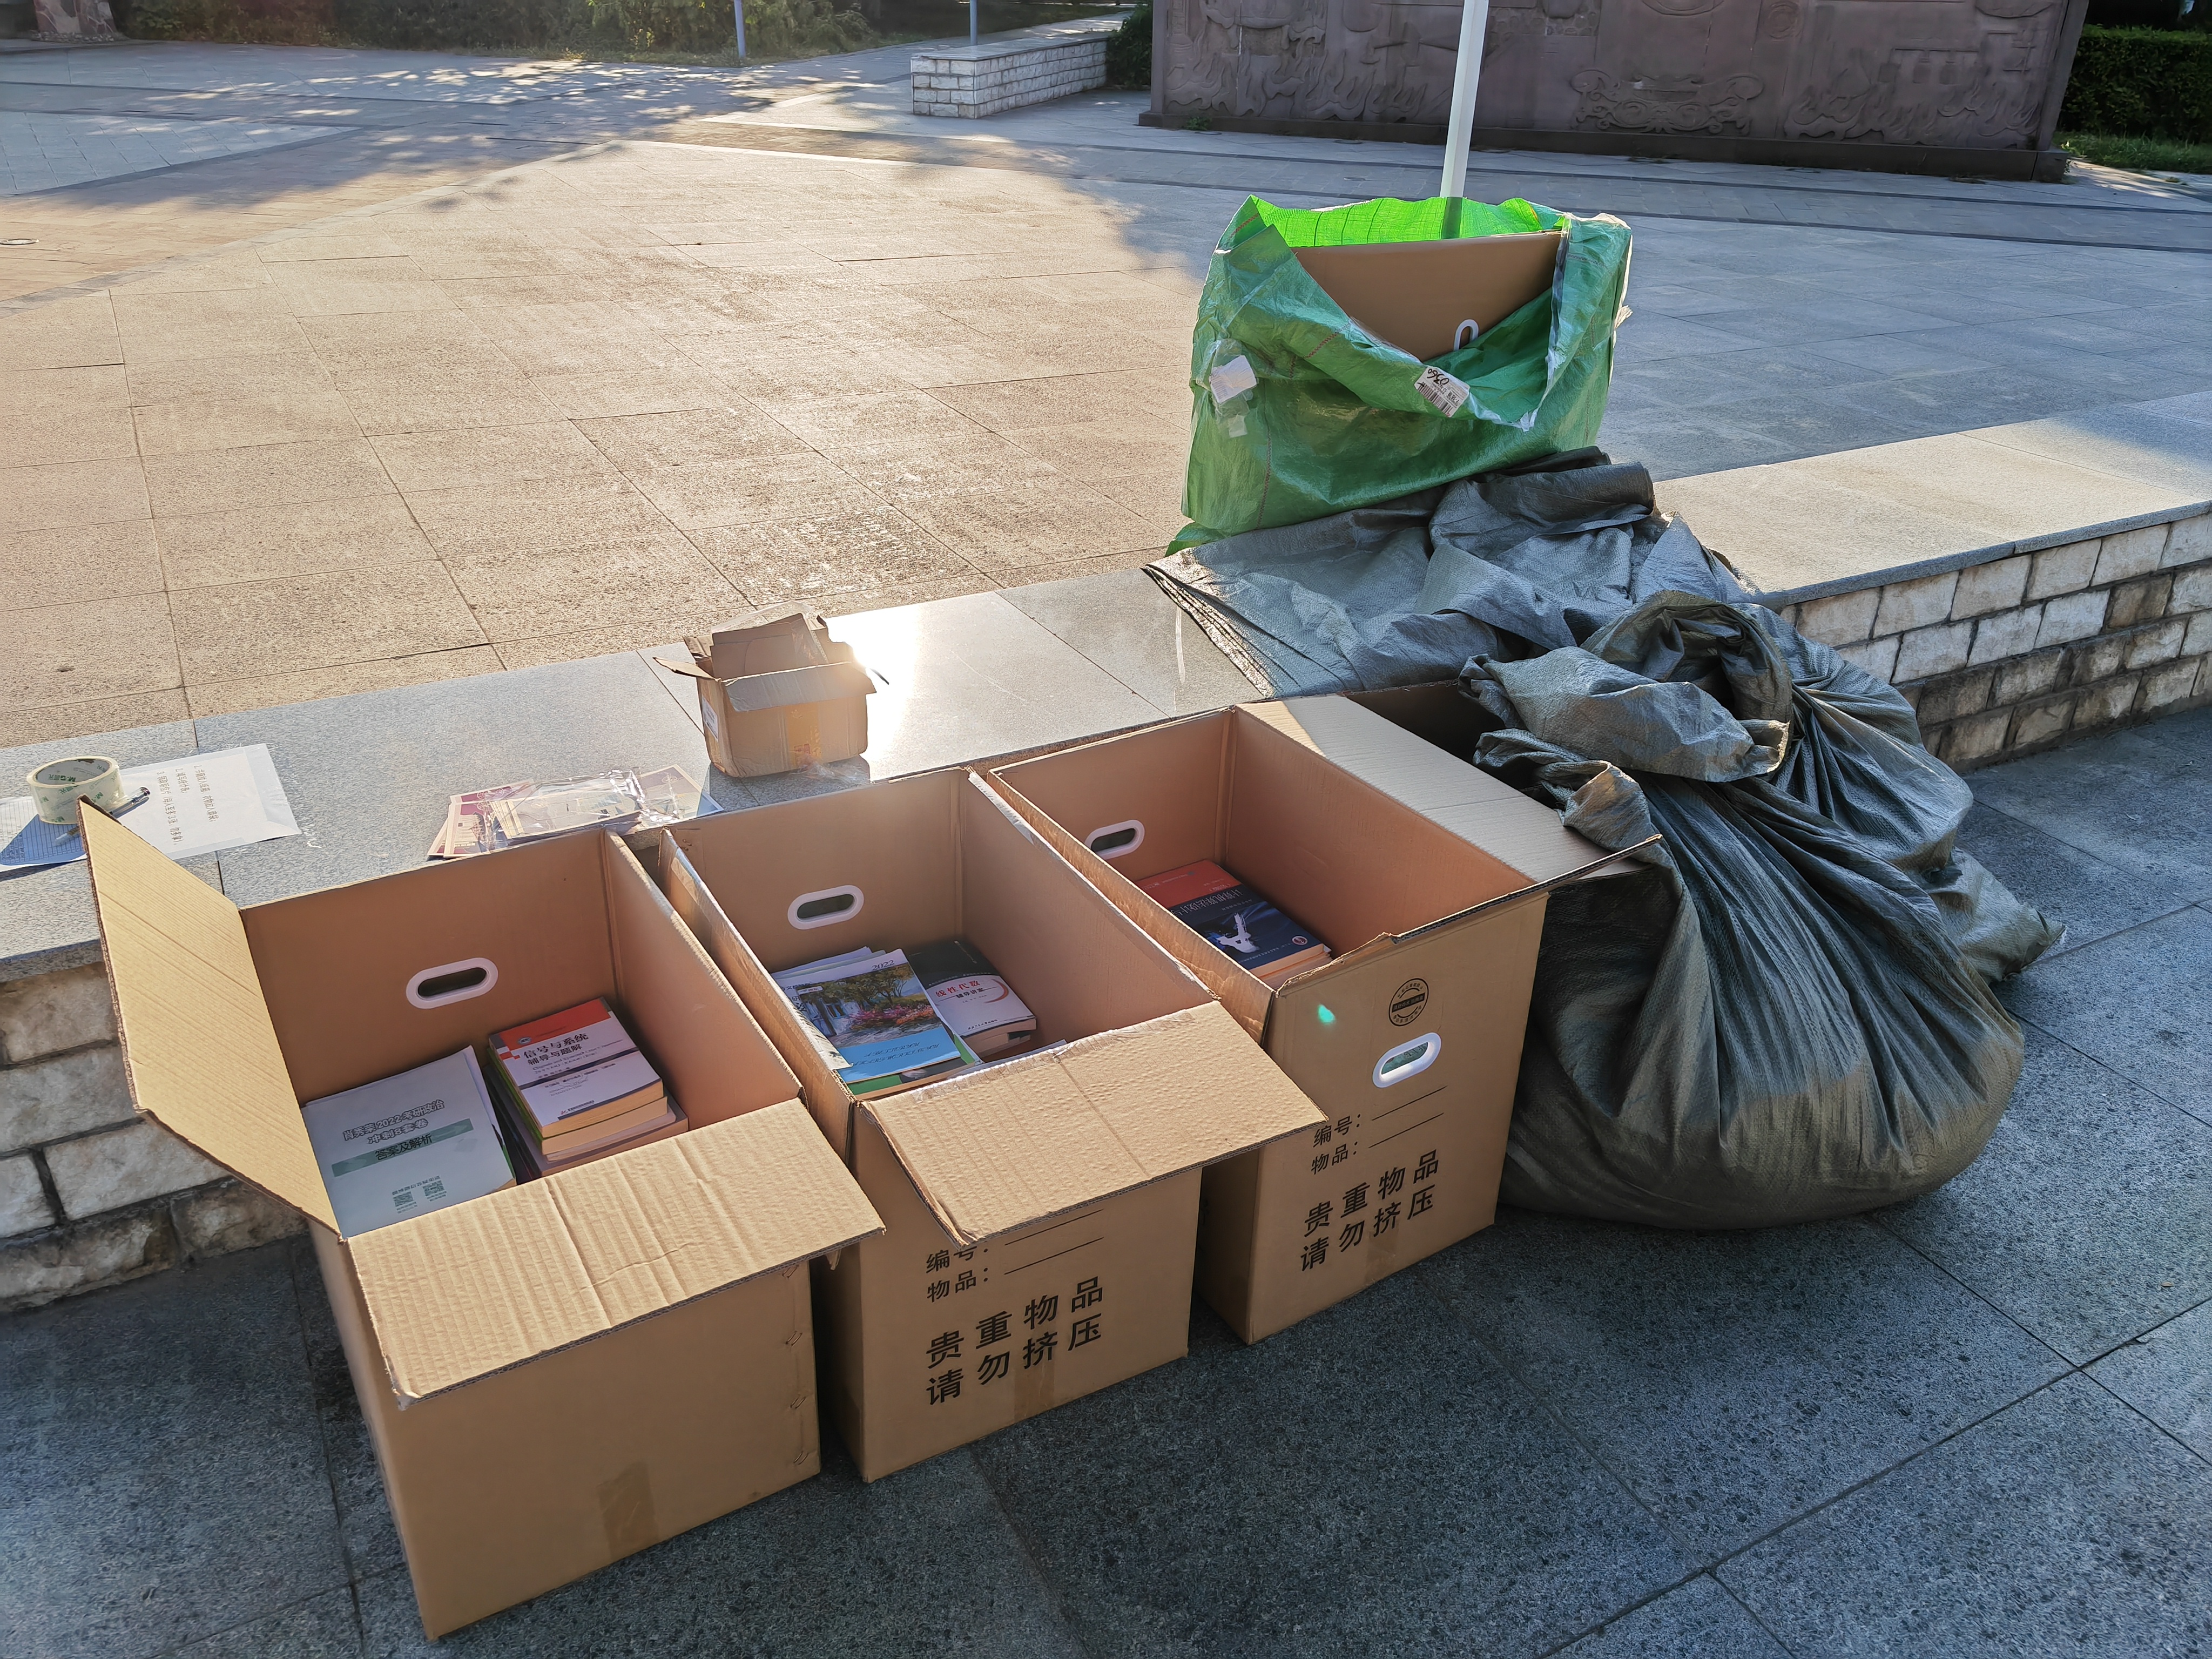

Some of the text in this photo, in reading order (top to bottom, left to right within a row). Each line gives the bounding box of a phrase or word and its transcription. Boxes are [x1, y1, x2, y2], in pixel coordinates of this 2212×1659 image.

[872, 960, 894, 970] 2022
[935, 969, 980, 997] 线性代数
[523, 1033, 589, 1059] 信号与系统
[528, 1043, 582, 1065] 辅导与题解
[367, 1118, 429, 1144] 冲刺8套卷
[375, 1133, 433, 1161] 答案及解析
[1313, 1114, 1361, 1148] 编号：
[1311, 1141, 1358, 1175] 物品：
[1304, 1149, 1439, 1238] 贵重物品
[1300, 1184, 1435, 1271] 请勿挤压
[927, 1267, 988, 1303] 物品：
[926, 1276, 1103, 1368] 贵重物品
[926, 1313, 1102, 1405] 请勿挤压
